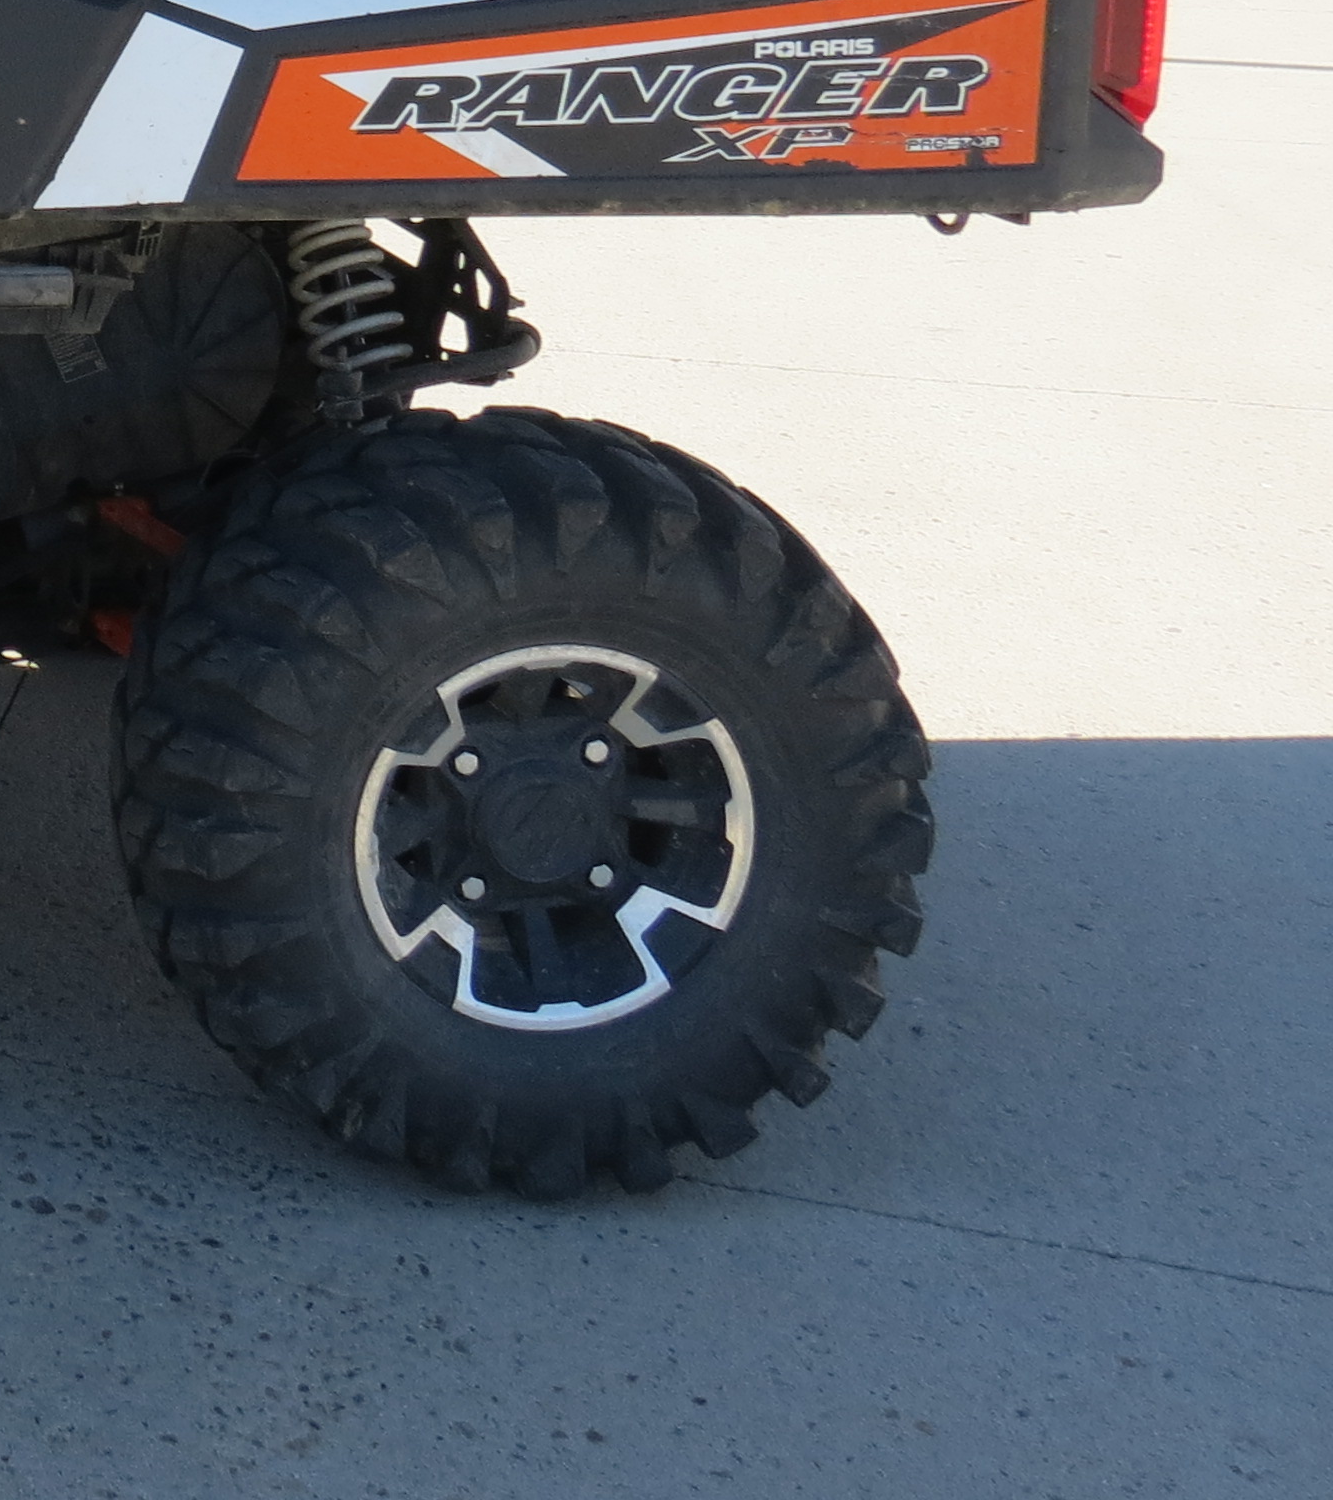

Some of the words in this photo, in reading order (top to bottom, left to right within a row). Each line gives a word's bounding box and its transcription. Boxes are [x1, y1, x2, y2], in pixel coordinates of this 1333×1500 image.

[754, 38, 875, 60] POLARIS
[349, 53, 990, 132] RANGER
[661, 122, 856, 163] XP
